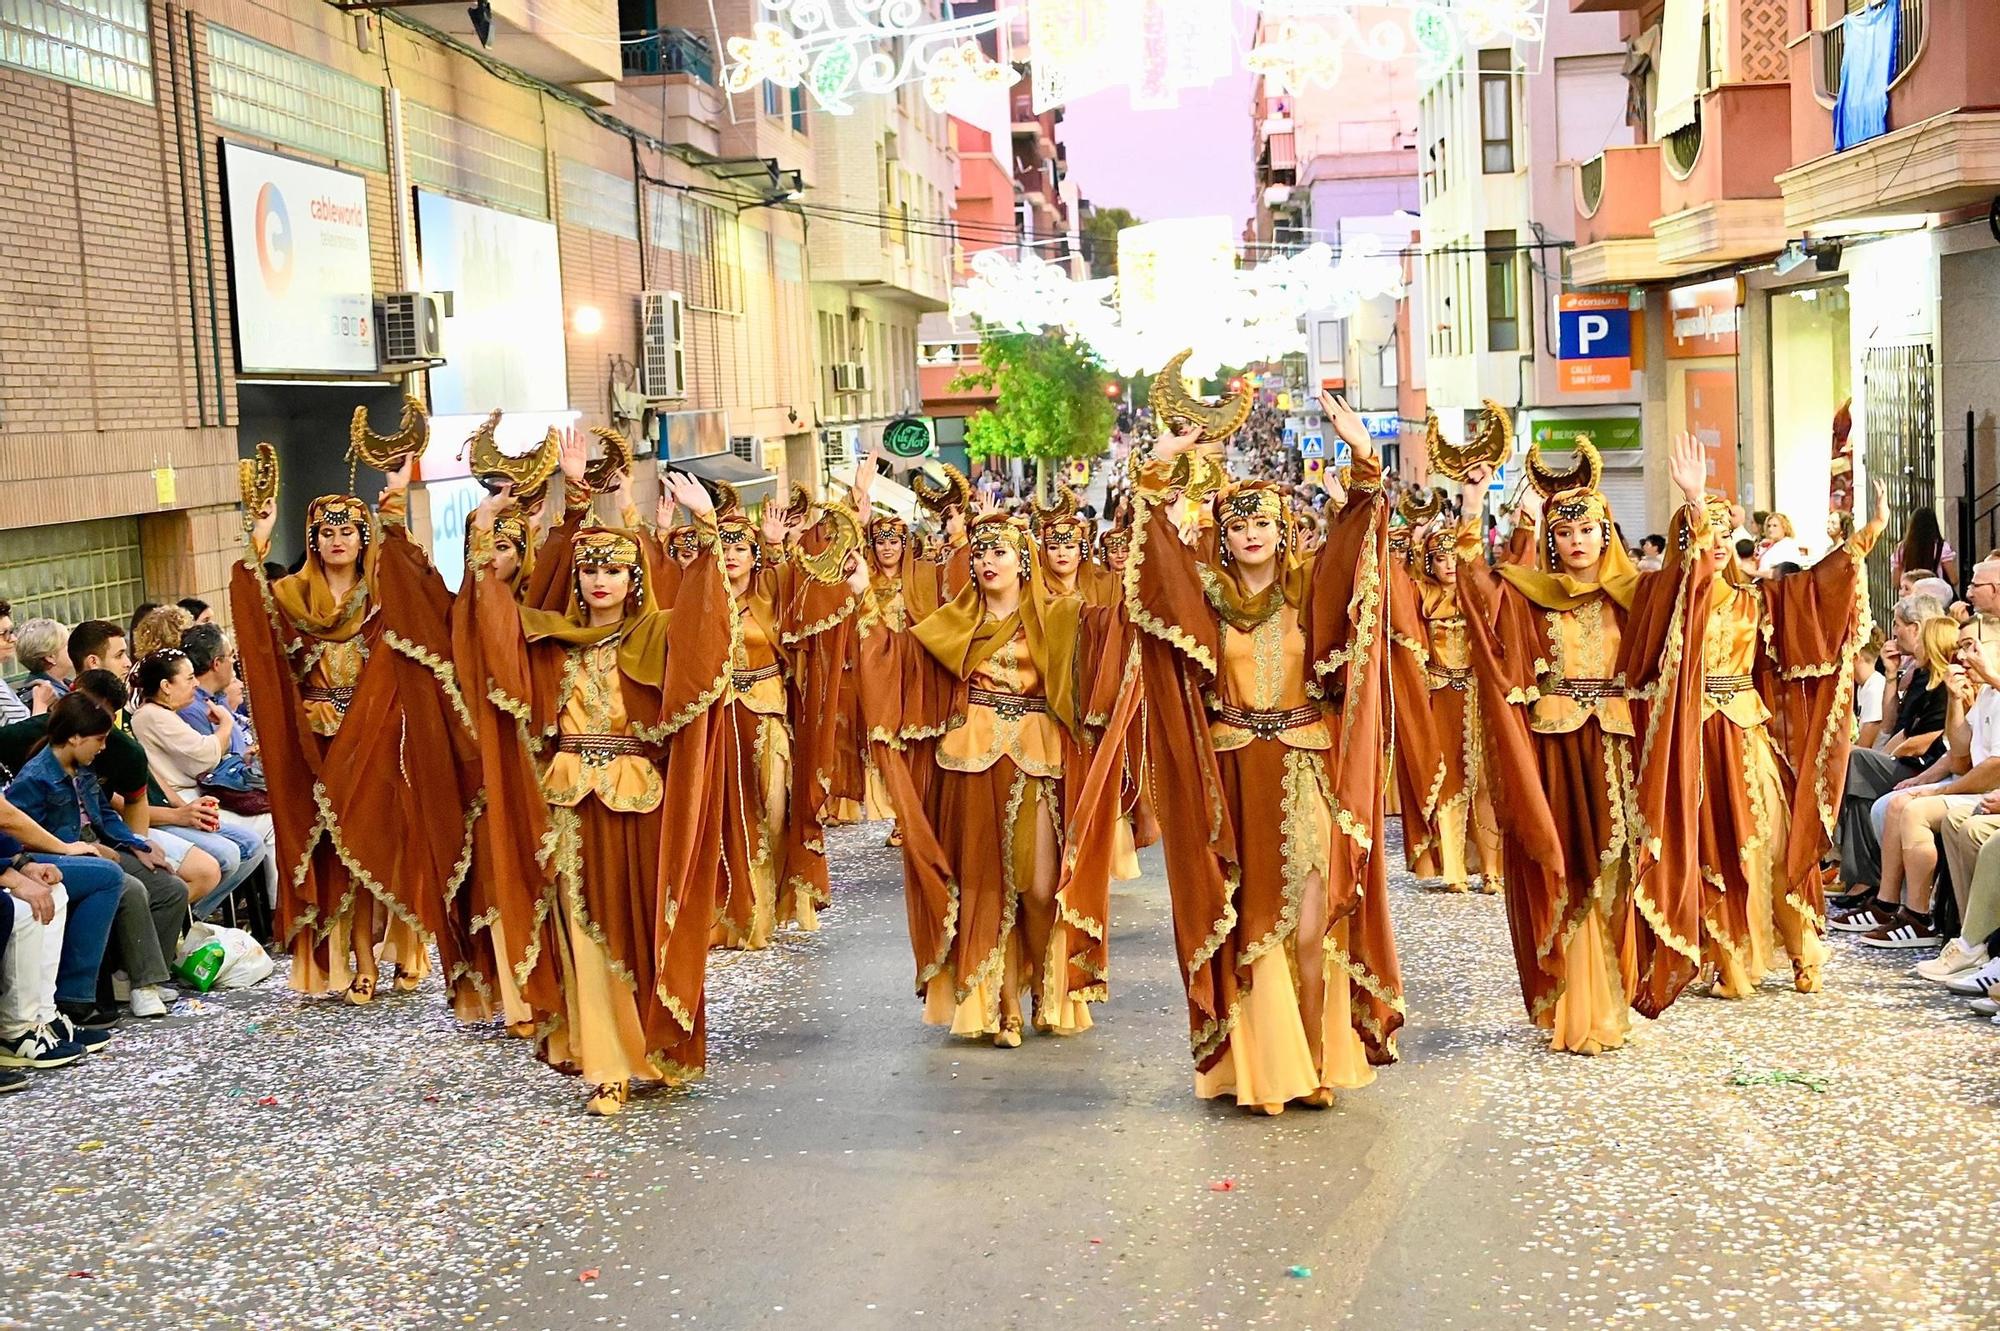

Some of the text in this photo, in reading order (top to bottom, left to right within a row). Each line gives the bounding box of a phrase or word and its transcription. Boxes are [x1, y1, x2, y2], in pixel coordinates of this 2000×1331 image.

[311, 195, 362, 228] cableworld
[1578, 315, 1609, 355] P
[1570, 364, 1593, 374] CALLE
[1571, 374, 1612, 385] SAN PEDRO
